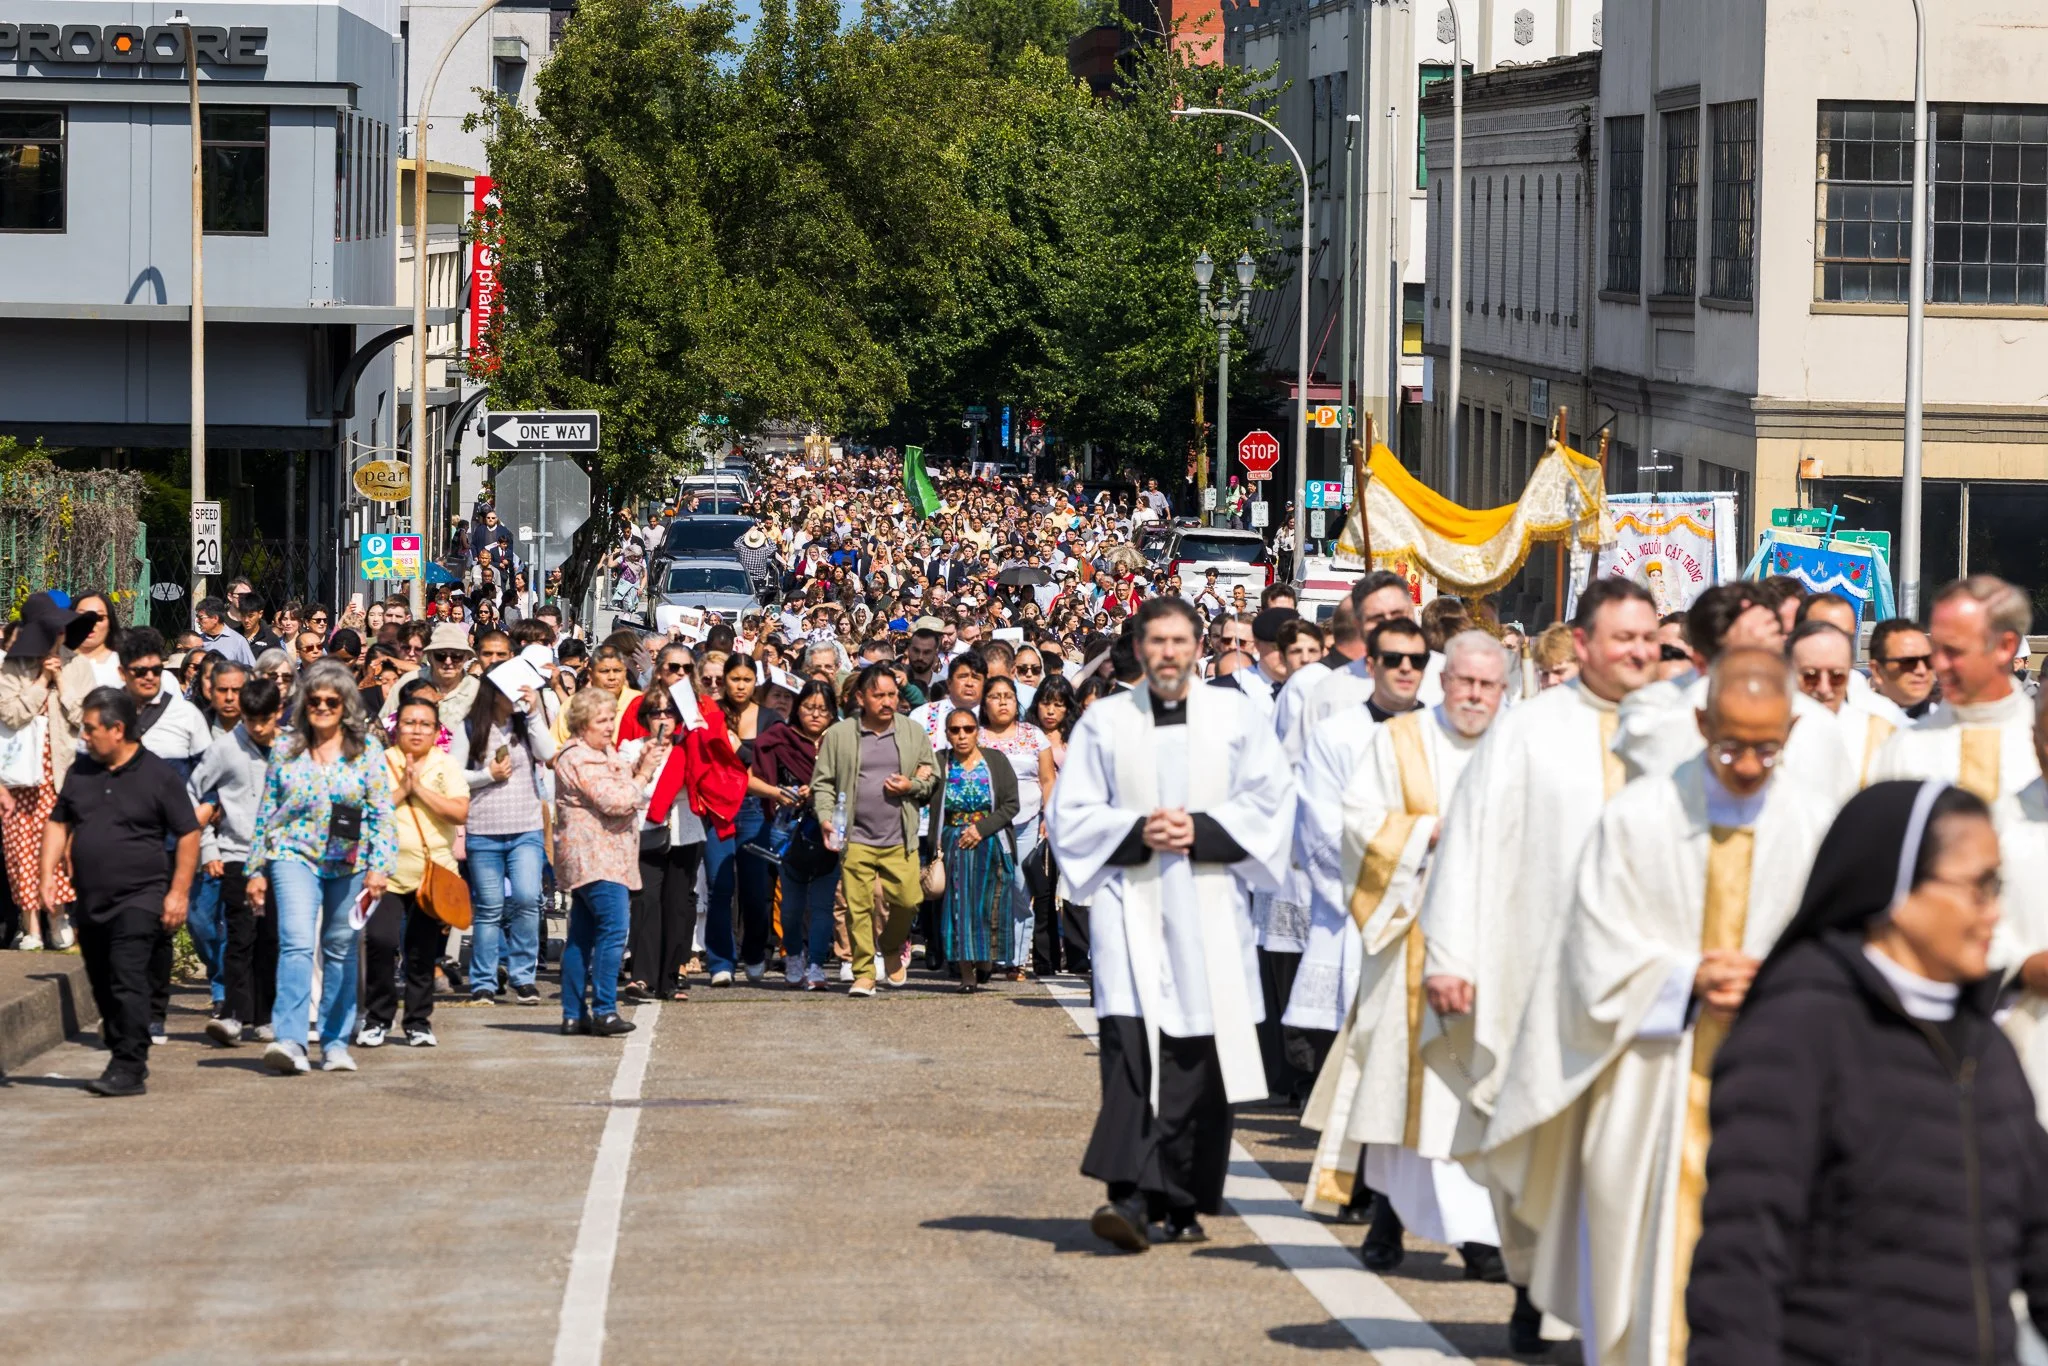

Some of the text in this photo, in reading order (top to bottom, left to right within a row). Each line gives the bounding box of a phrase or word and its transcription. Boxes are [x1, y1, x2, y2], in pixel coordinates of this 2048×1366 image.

[520, 425, 586, 439] ONE WAY
[1241, 444, 1277, 460] STOP
[365, 467, 410, 485] pearl
[1311, 494, 1320, 504] 2
[195, 509, 218, 520] SPEED
[198, 524, 216, 535] LIMIT
[196, 539, 218, 565] 20
